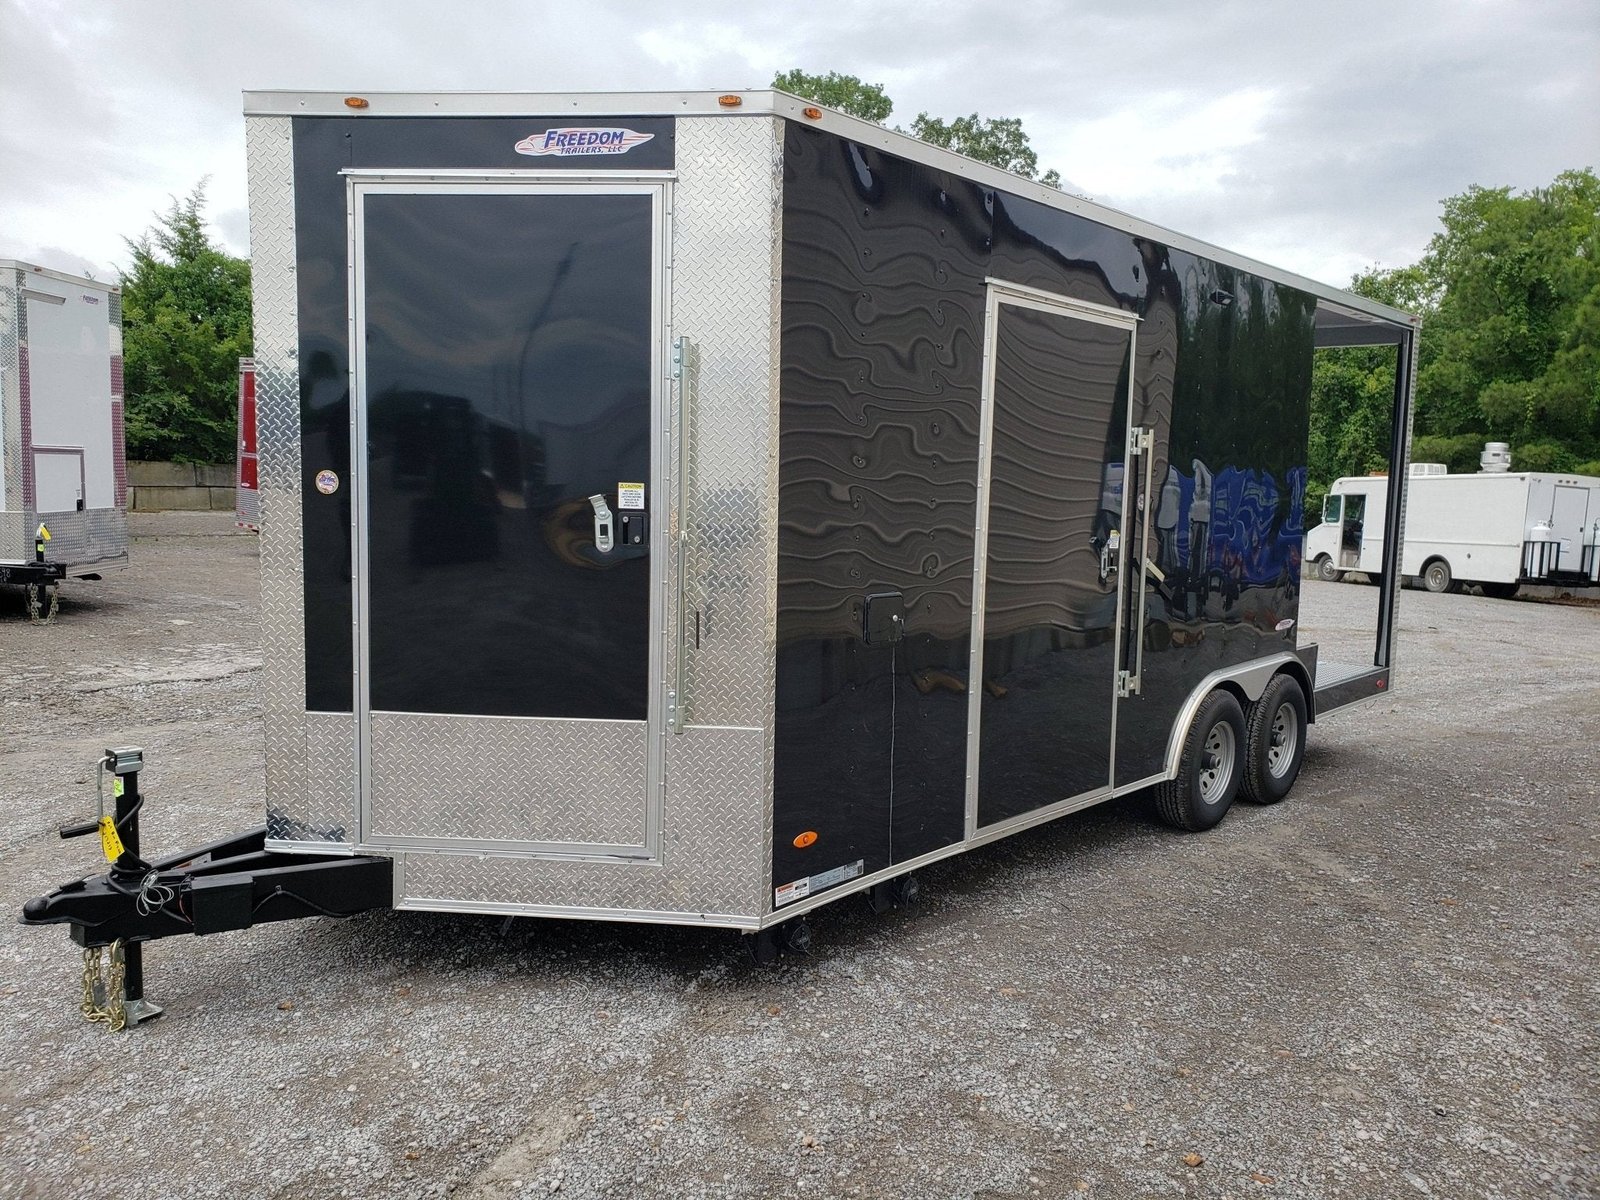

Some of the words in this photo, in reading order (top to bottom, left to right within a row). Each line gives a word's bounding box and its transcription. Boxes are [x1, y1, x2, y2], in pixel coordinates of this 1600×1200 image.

[544, 131, 625, 148] FREEDOM
[560, 147, 603, 155] TRAILERS,
[607, 145, 622, 153] LLC
